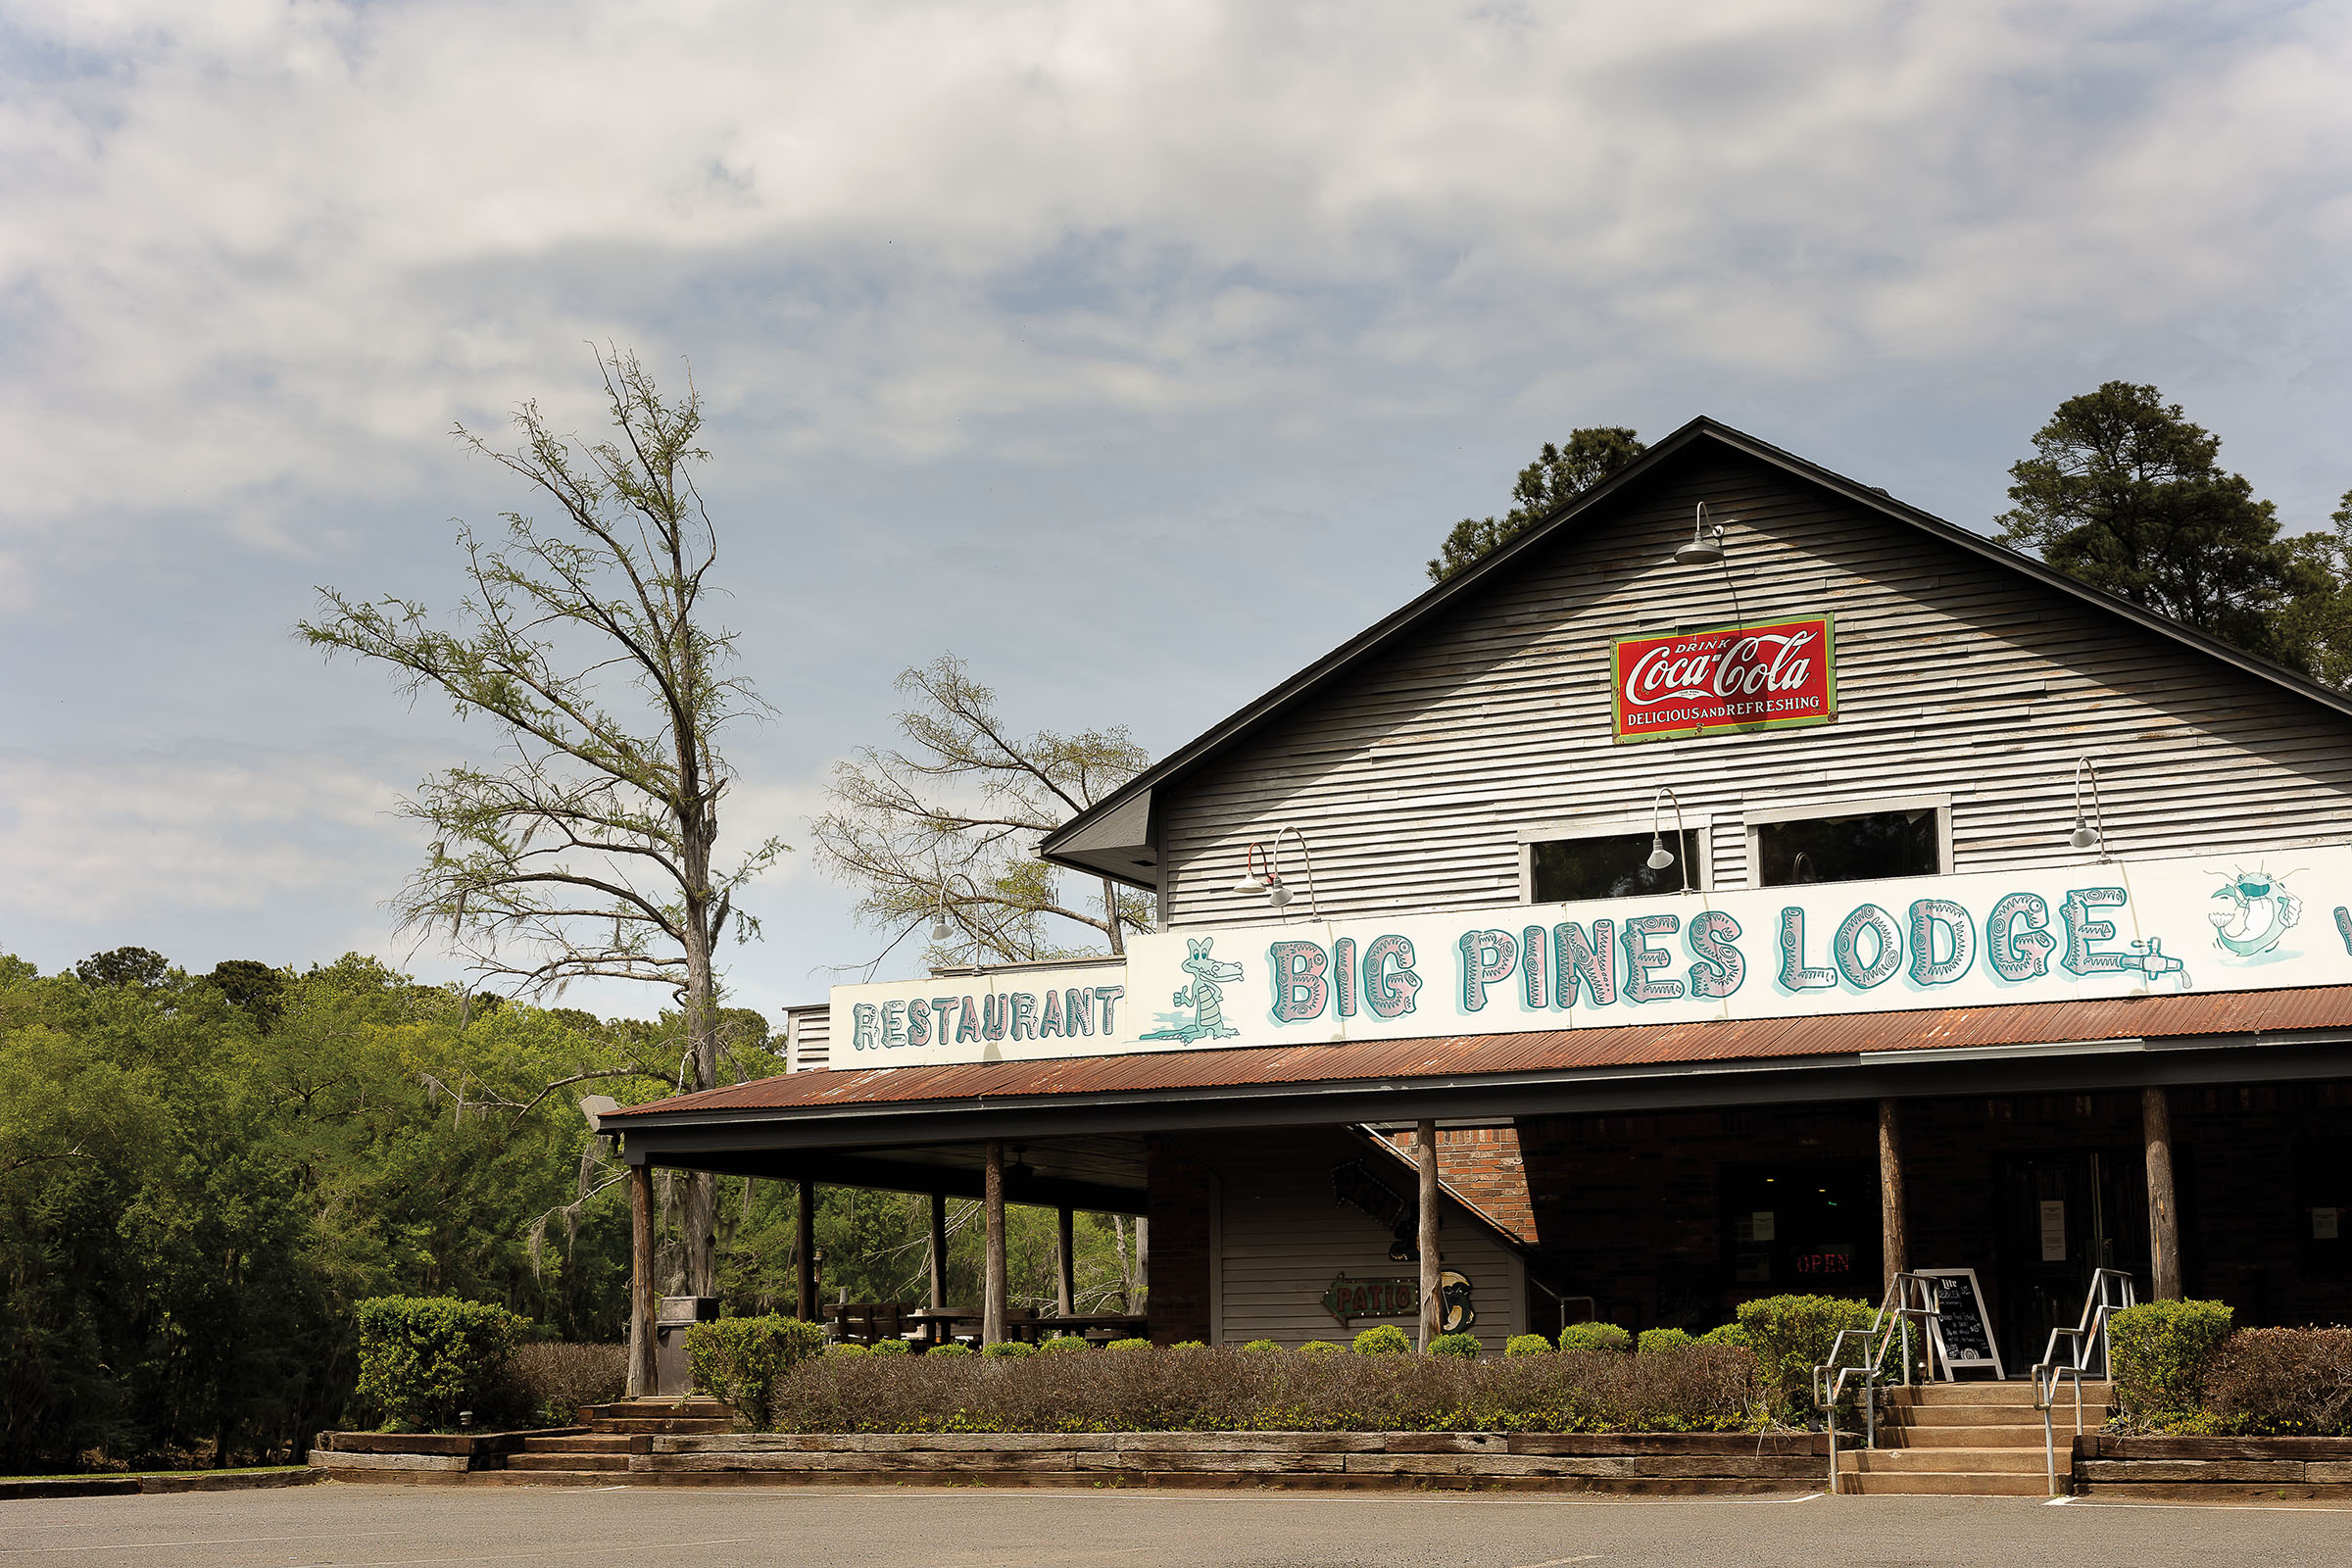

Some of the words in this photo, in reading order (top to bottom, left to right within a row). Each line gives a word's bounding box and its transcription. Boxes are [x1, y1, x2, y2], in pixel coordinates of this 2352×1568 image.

[1674, 639, 1730, 655] DRINK
[1625, 630, 1819, 706] Coca-Cola
[1627, 707, 1700, 726] DELICIOUS
[1700, 707, 1725, 719] AND
[1726, 695, 1820, 716] REFRESHING
[1270, 935, 1423, 1022] BIG
[1458, 910, 1748, 1009] PINES
[1775, 887, 2127, 990] LODGE
[851, 985, 1125, 1051] RESTAURANT
[1796, 1253, 1850, 1273] OPEN
[1336, 1285, 1410, 1311] PATIO
[1941, 1278, 1957, 1290] Lite
